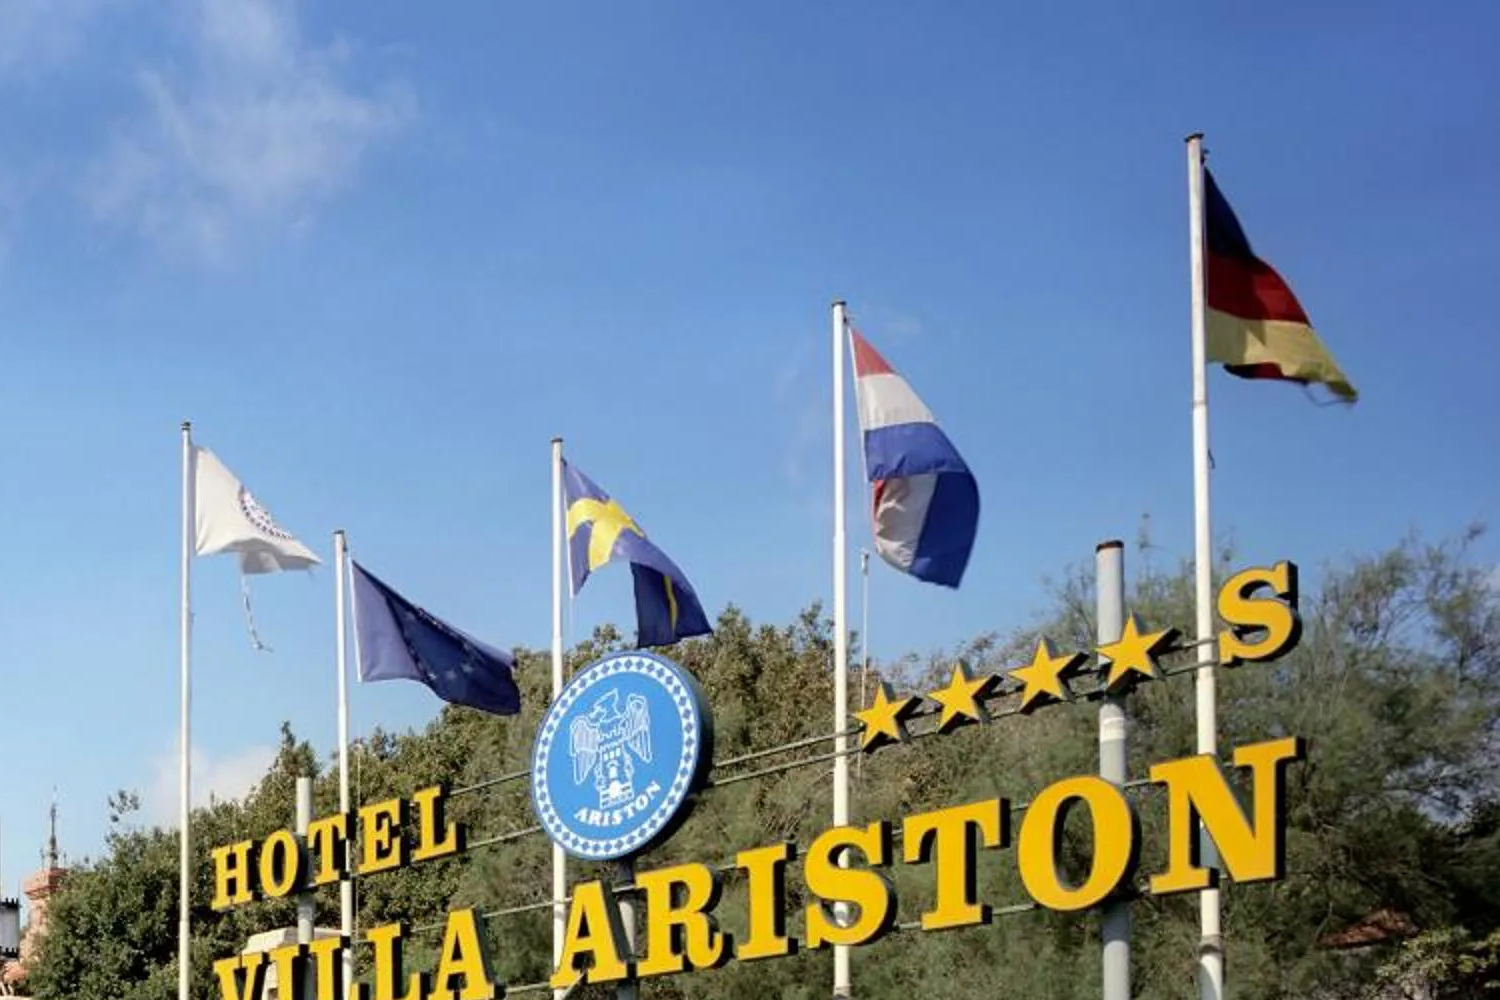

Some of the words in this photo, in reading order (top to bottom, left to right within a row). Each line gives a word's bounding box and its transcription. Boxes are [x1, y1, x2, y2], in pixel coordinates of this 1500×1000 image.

[1217, 559, 1296, 665] S
[211, 785, 460, 911] HOTEL
[574, 780, 661, 826] ARISTON
[549, 736, 1300, 990] ARISTON
